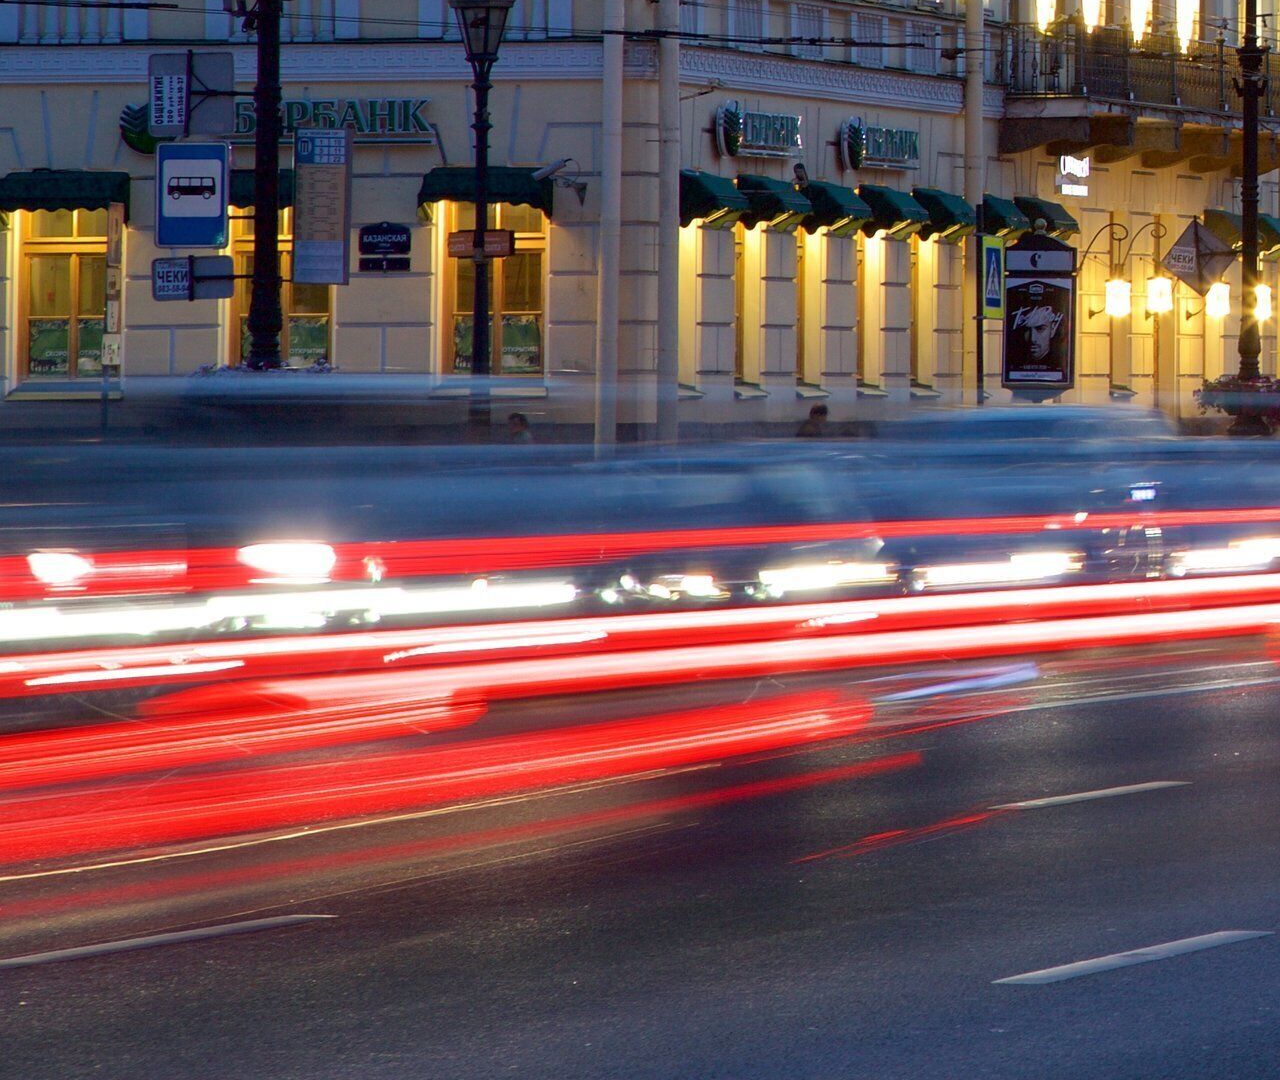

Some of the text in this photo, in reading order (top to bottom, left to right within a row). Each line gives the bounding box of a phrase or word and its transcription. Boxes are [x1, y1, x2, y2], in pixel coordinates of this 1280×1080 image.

[154, 76, 165, 125] ОБЩЕЖИТИЕ
[362, 233, 407, 243] КАЗАНСКАЯ
[1170, 254, 1195, 265] ЧЕКИ
[157, 270, 188, 283] ЧЕКИ
